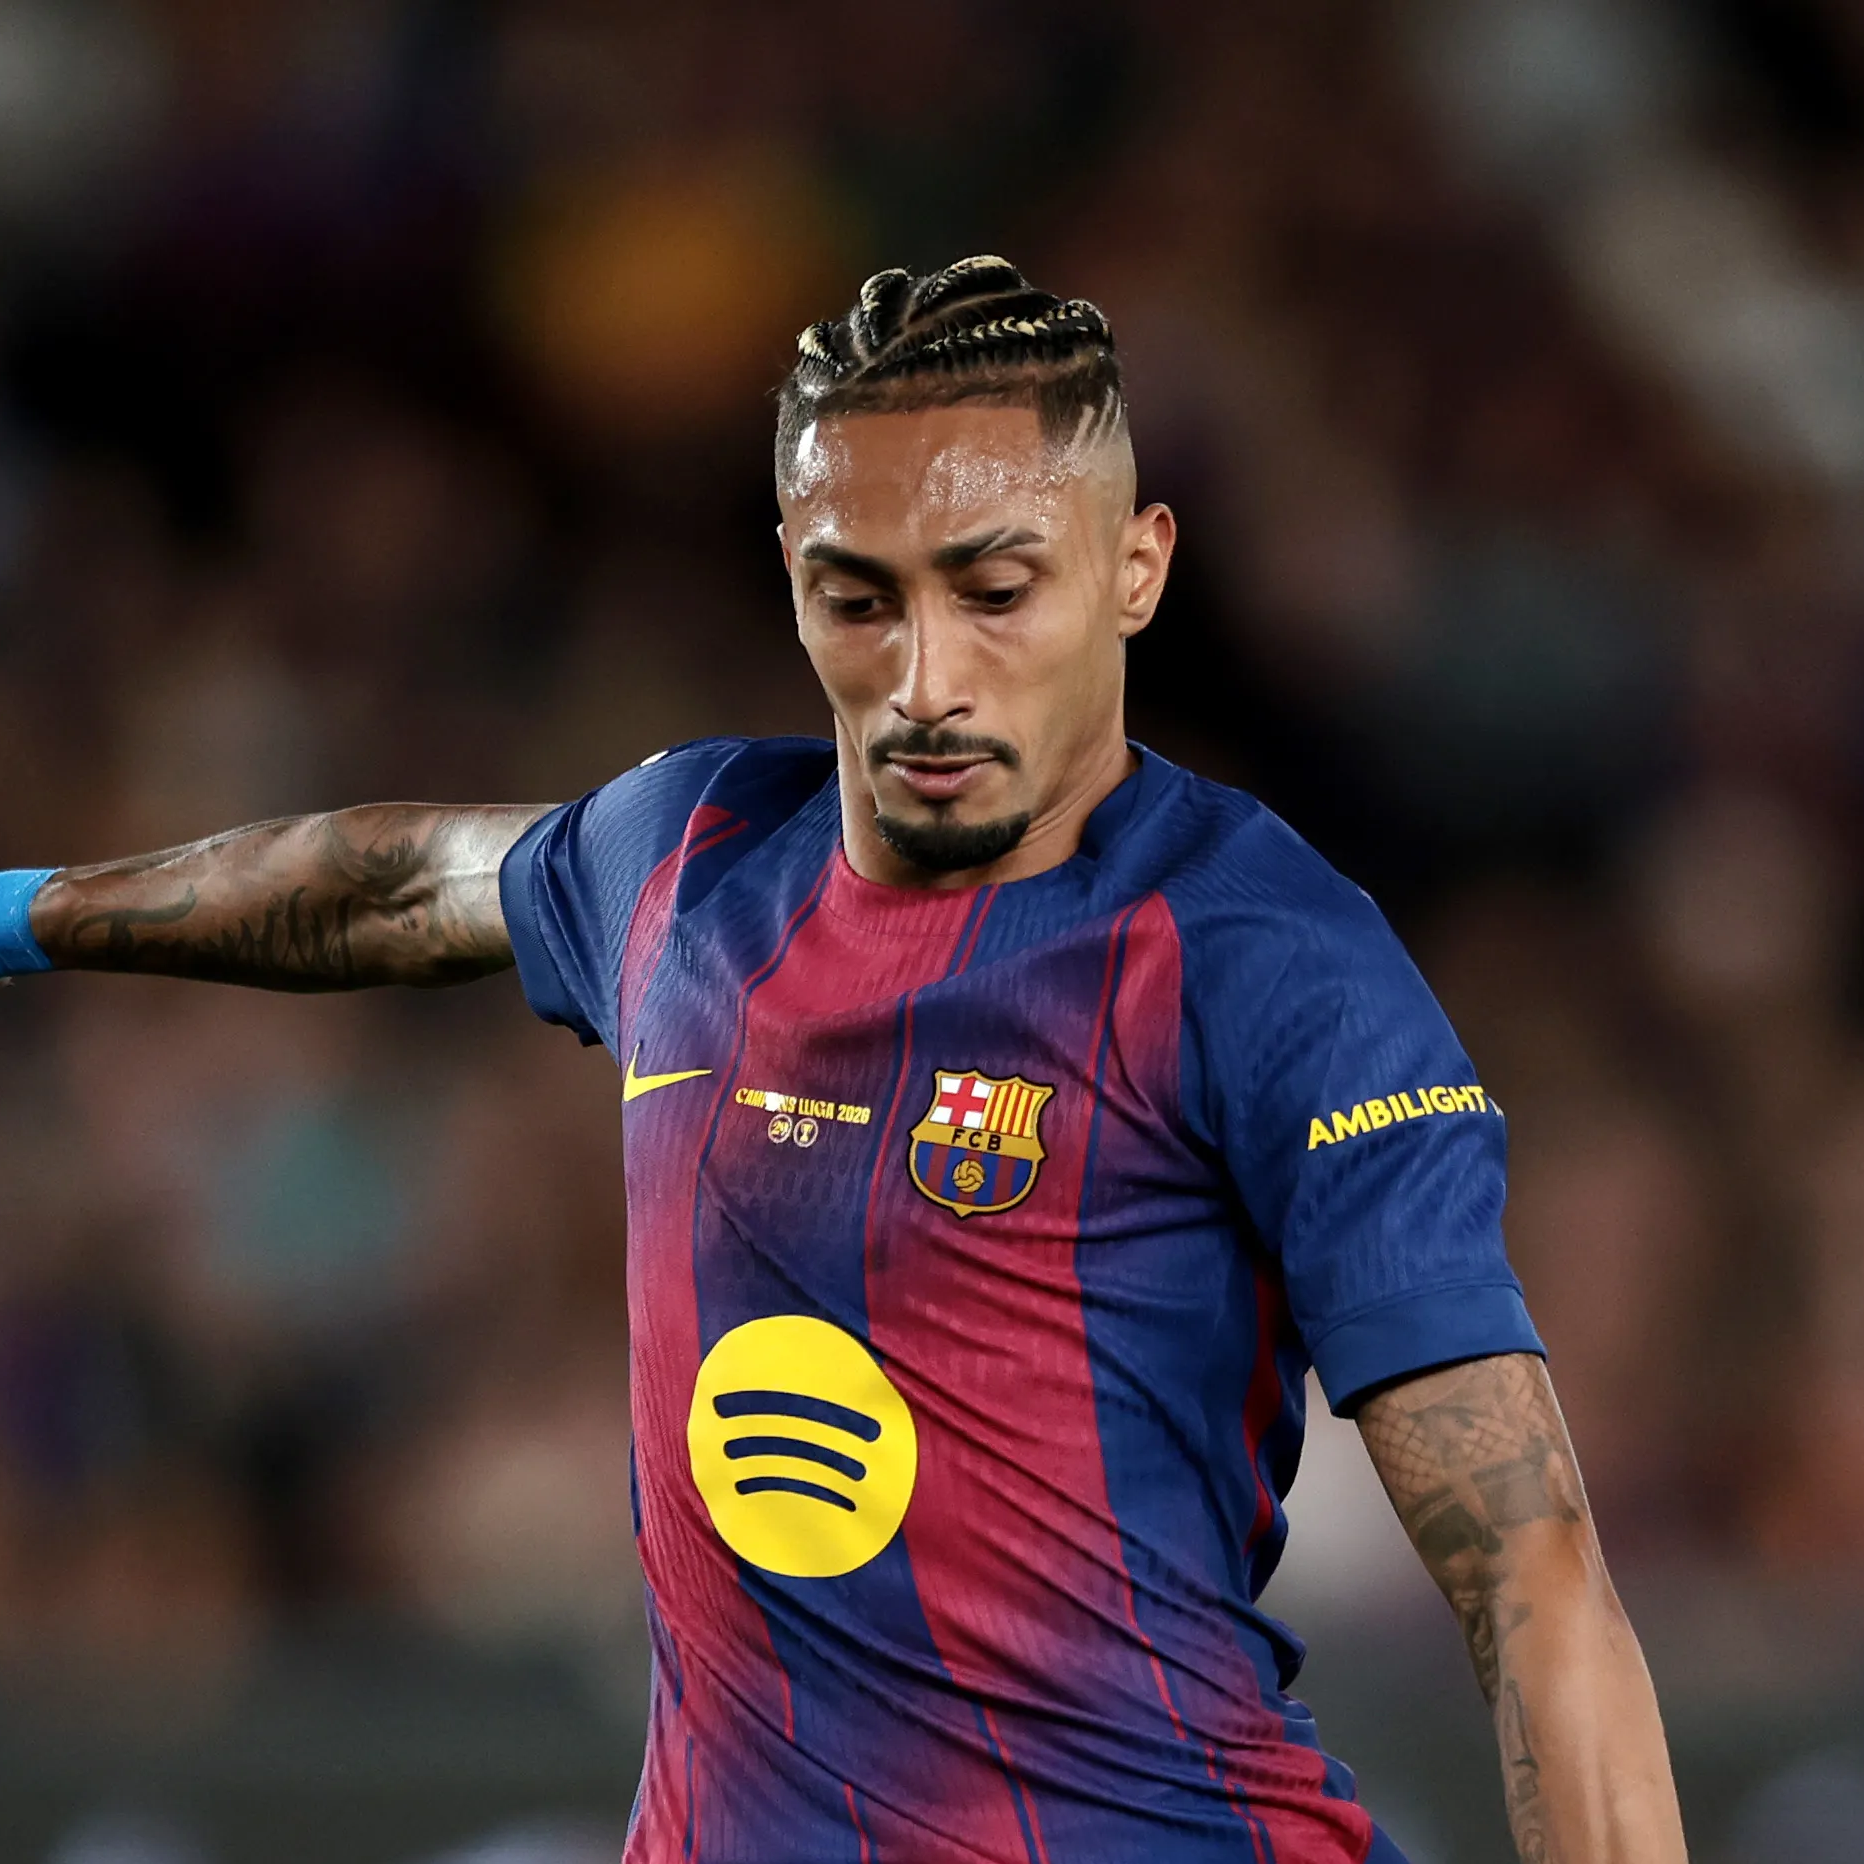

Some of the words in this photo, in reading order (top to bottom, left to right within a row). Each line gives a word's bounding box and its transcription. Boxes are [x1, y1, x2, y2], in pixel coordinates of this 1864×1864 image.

[798, 1098, 835, 1121] LLIGA
[1307, 1085, 1486, 1151] AMBILIGHT
[951, 1127, 1002, 1152] FCB
